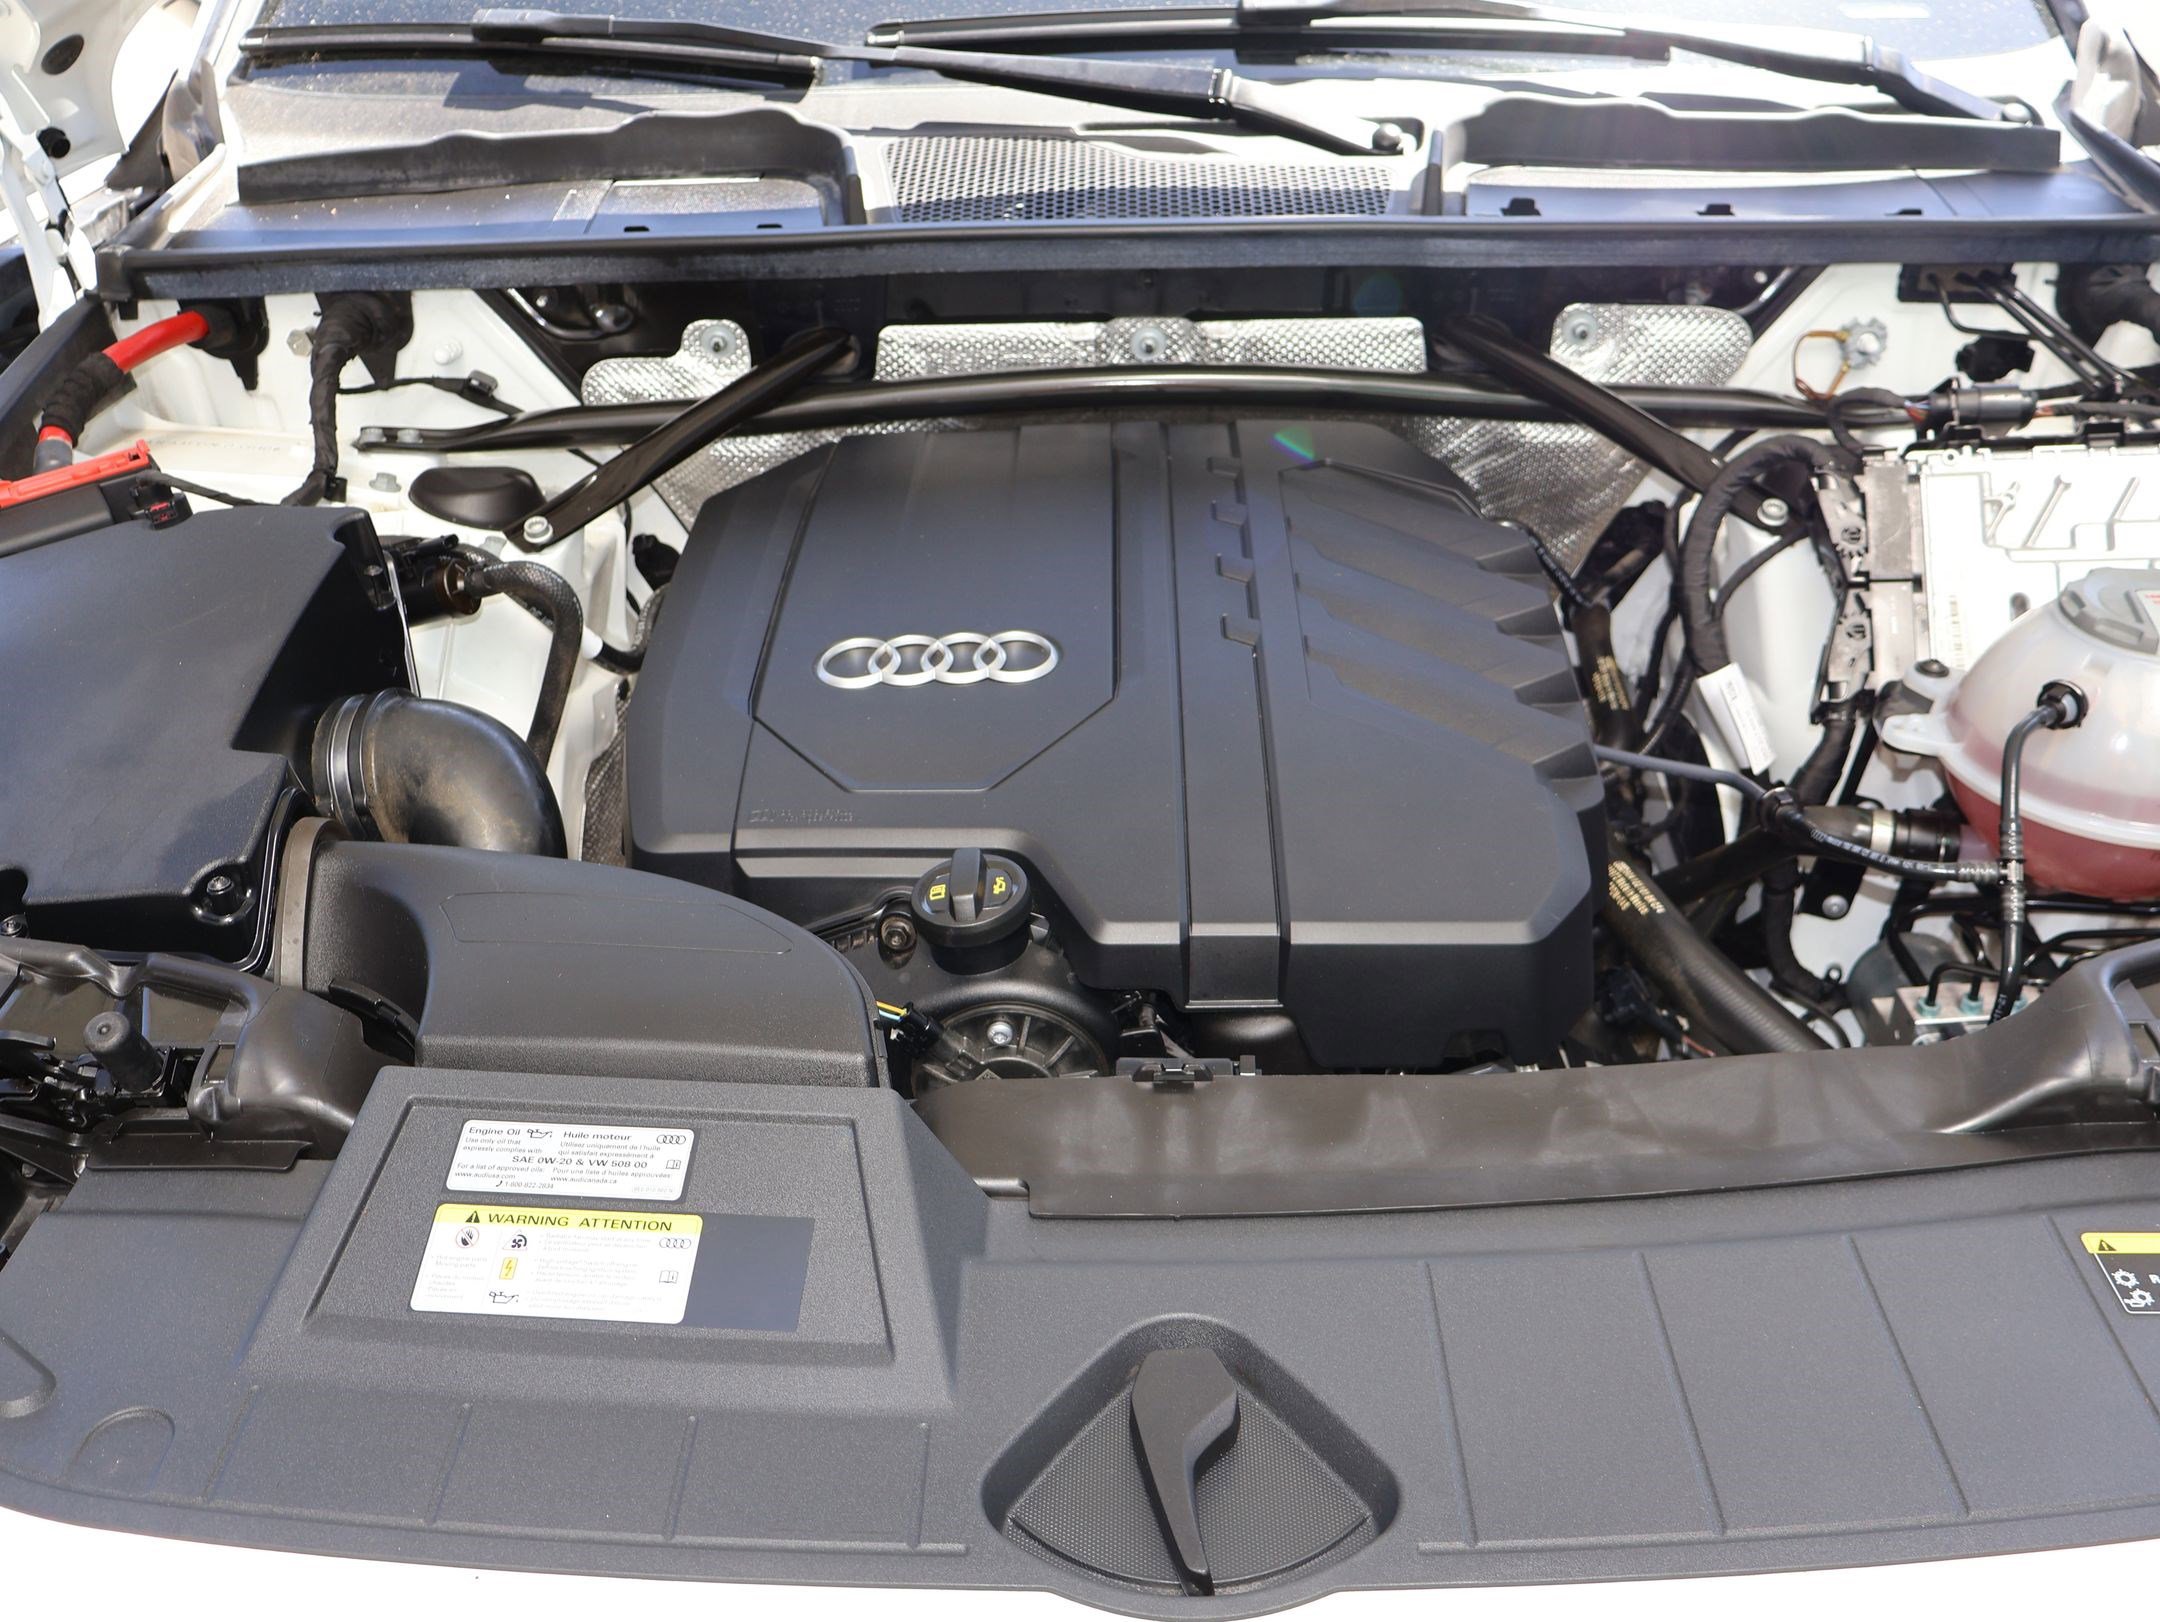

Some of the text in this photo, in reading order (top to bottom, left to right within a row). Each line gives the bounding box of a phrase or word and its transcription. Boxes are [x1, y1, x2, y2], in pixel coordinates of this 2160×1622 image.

[469, 1126, 504, 1136] Engine
[563, 1131, 632, 1141] Huile moteur
[495, 1146, 526, 1154] complies
[512, 1155, 535, 1163] SAE
[537, 1157, 573, 1165] 0W-20
[588, 1159, 608, 1167] VW
[488, 1213, 673, 1231] WARNING ATTENTION
